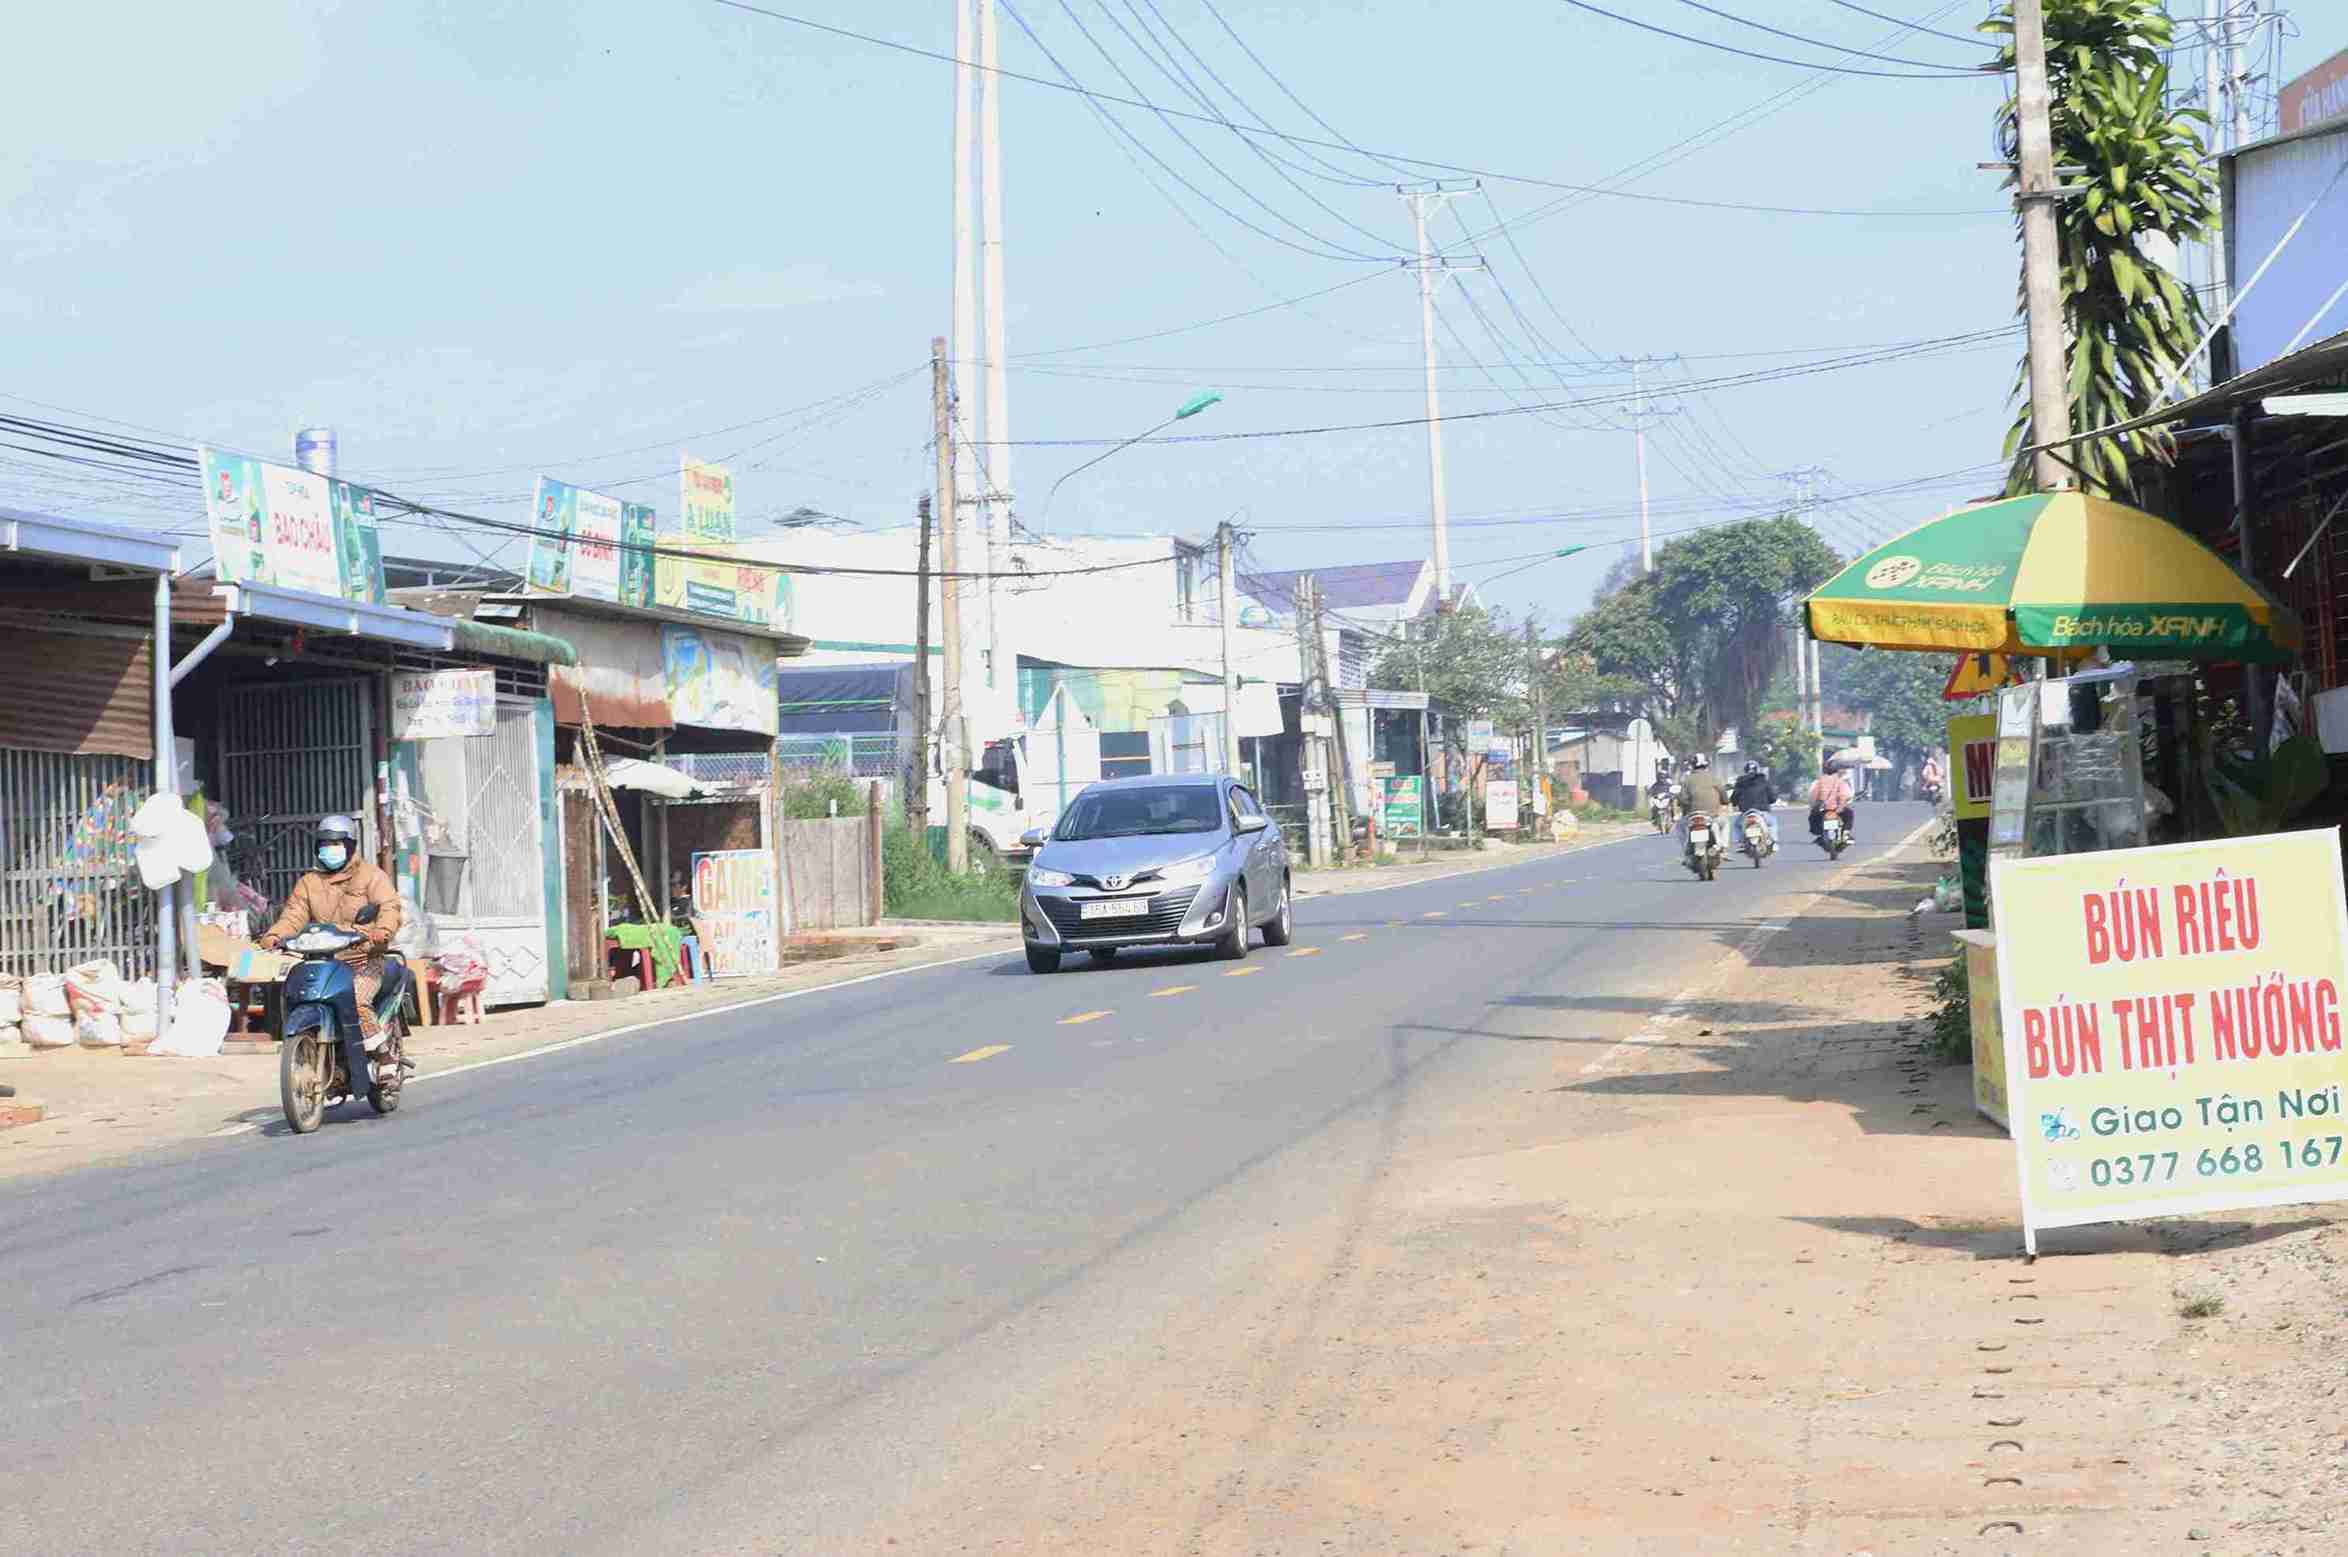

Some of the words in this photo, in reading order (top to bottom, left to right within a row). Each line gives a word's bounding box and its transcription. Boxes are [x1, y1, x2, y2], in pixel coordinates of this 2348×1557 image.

[2052, 614, 2103, 637] Bách
[2107, 614, 2144, 637] hóa
[2145, 615, 2226, 638] XANH
[2084, 878, 2163, 964] BÚN
[2174, 867, 2260, 955] RIÊU
[2023, 993, 2103, 1079] BÚN
[2112, 992, 2195, 1081] THỊT
[2210, 970, 2343, 1061] NƯỚNG
[2091, 1105, 2183, 1136] Giao
[2196, 1093, 2264, 1133] Tận
[2278, 1085, 2341, 1119] Nơi
[2091, 1151, 2179, 1187] 0377
[2196, 1143, 2264, 1177] 668
[2279, 1136, 2344, 1169] 167
